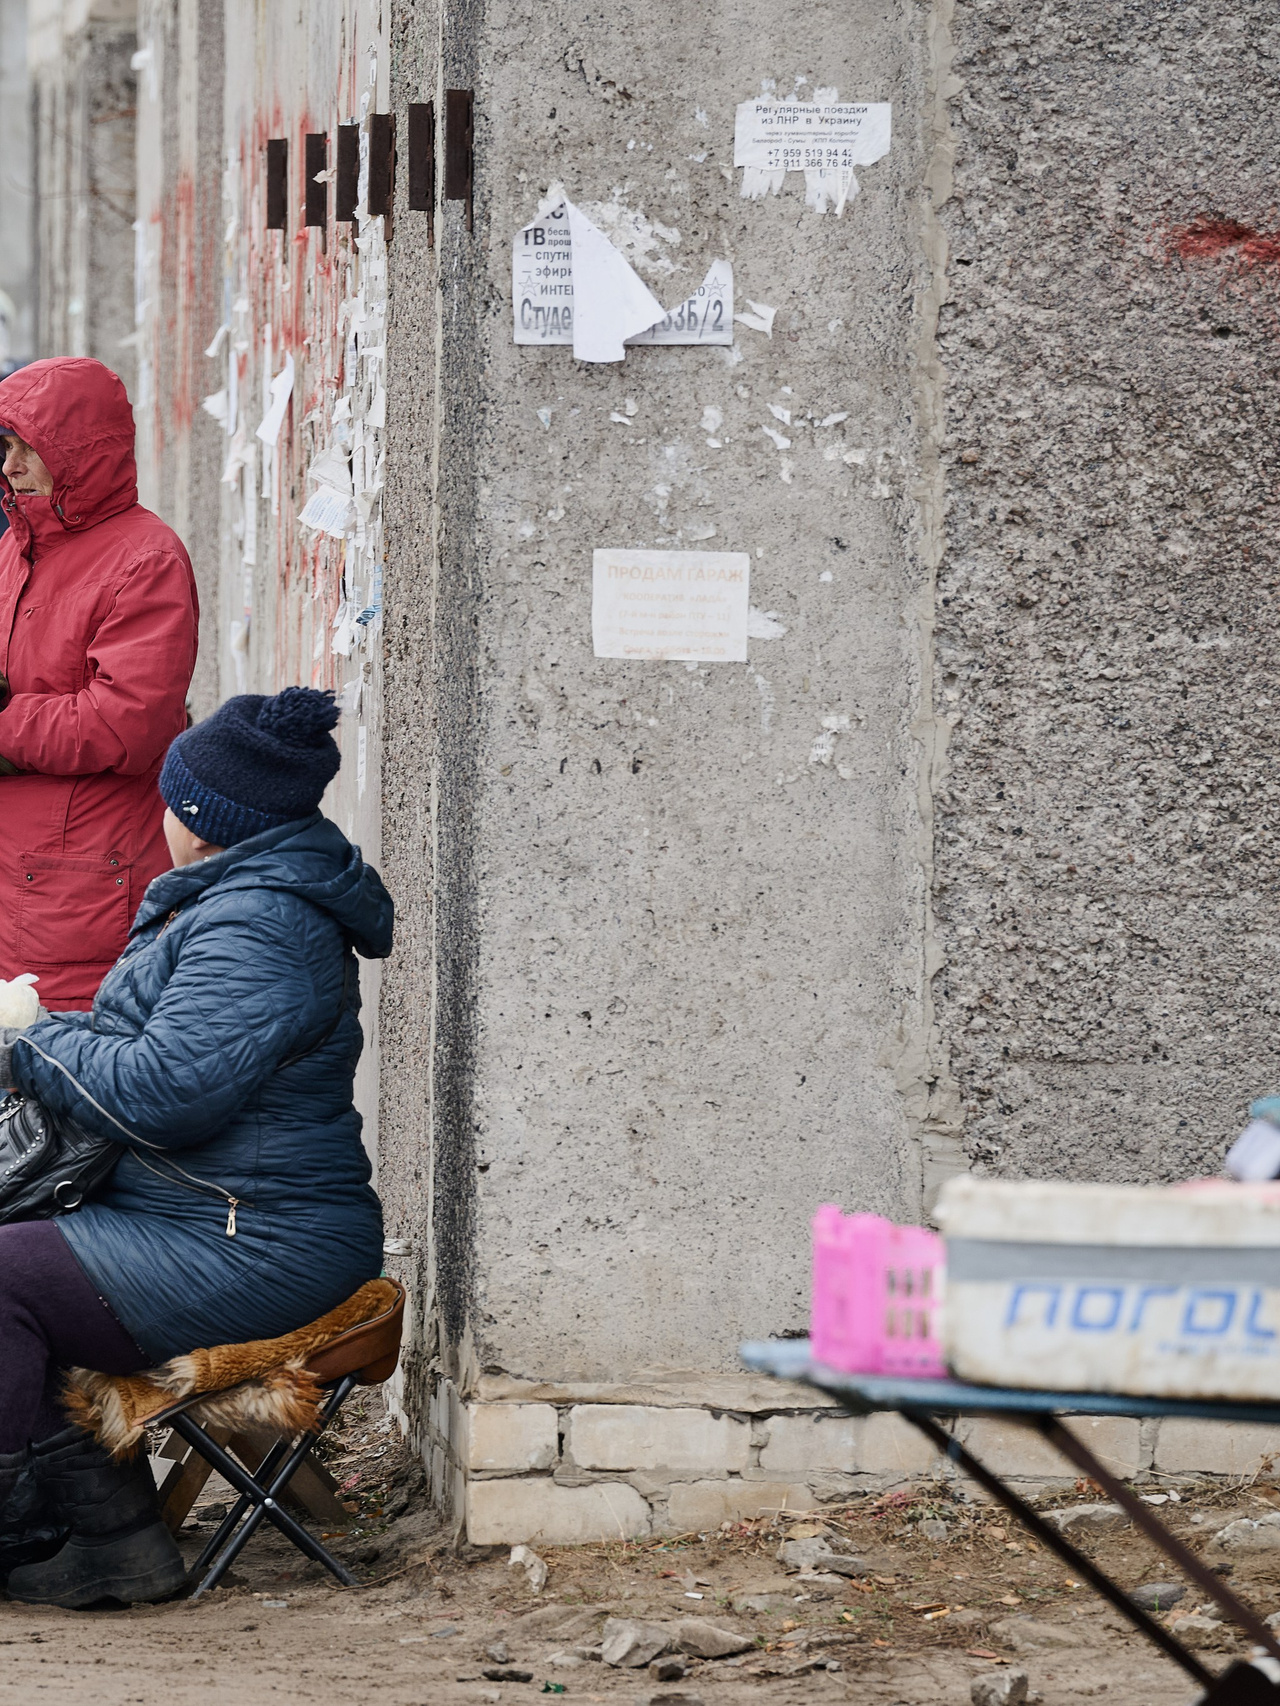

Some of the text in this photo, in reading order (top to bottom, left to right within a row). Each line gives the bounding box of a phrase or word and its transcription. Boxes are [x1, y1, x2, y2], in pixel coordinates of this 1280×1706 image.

[823, 106, 869, 116] поездки
[761, 116, 862, 126] из ЛНР в Украину
[768, 149, 780, 158] +7
[782, 149, 802, 158] 959
[805, 149, 823, 158] 519
[826, 149, 839, 158] 94
[768, 159, 780, 168] +7
[782, 159, 801, 168] 911
[804, 159, 823, 168] 366
[826, 159, 839, 168] 76
[523, 227, 546, 247] ТВ
[535, 251, 572, 263] спутн
[540, 284, 574, 296] ИНТЕ
[521, 298, 574, 338] Студе
[608, 565, 744, 583] ПРОДАМ ГАРАЖ
